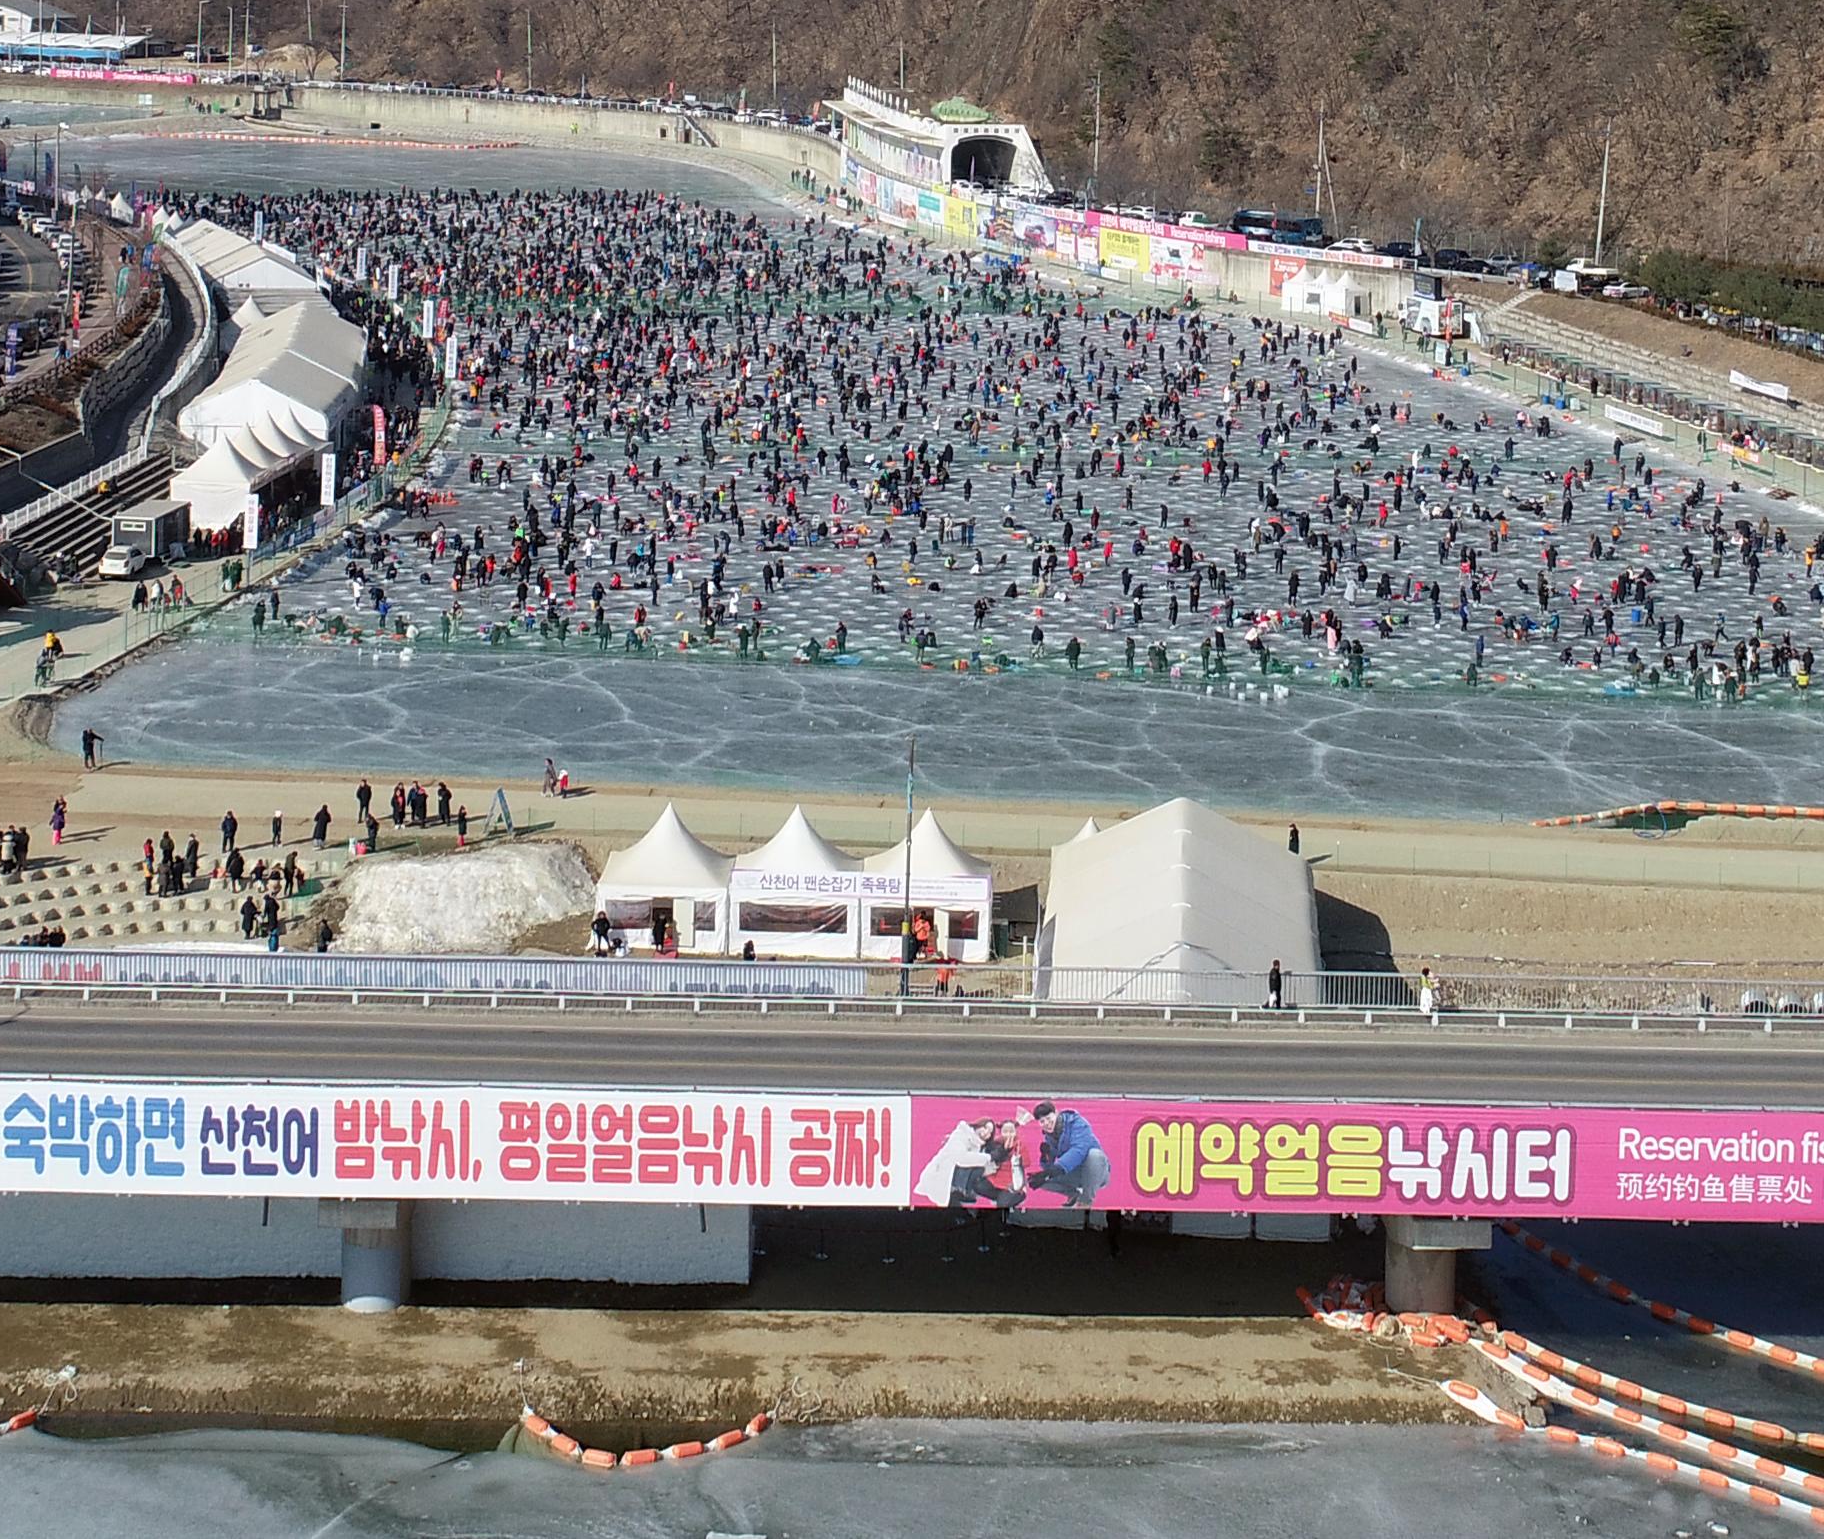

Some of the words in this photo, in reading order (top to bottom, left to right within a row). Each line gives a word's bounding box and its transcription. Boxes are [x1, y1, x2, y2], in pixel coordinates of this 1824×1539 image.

[759, 874, 800, 892] 산천어
[804, 875, 857, 893] 맨손잡기
[861, 877, 902, 895] 족욕탕
[3, 1092, 186, 1176] 숙박하면
[199, 1102, 319, 1178] 산천어
[334, 1098, 482, 1183] 밤낚시,
[498, 1101, 772, 1187] 평일얼음낚시
[789, 1106, 891, 1189] 공짜!
[1618, 1127, 1795, 1164] Reservation
[1135, 1121, 1571, 1201] 예약얼음낚시터
[1616, 1172, 1812, 1204] 预约钓鱼售票处
